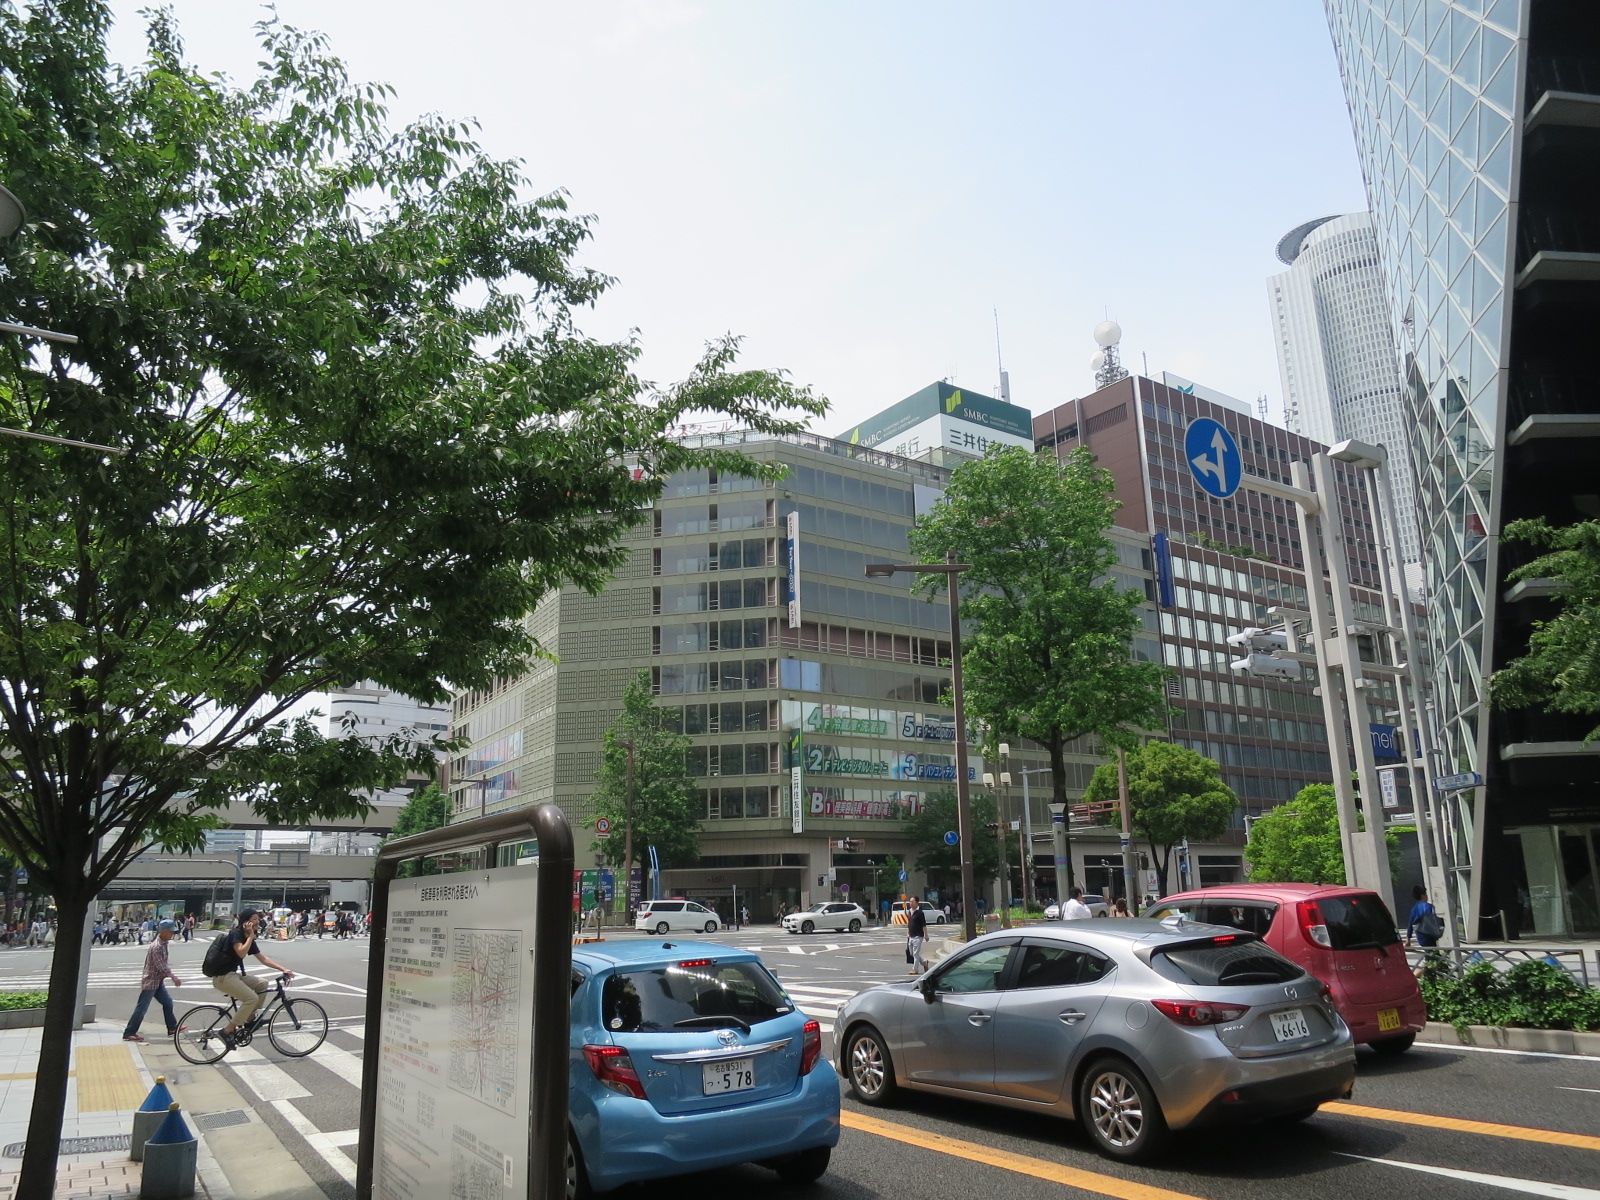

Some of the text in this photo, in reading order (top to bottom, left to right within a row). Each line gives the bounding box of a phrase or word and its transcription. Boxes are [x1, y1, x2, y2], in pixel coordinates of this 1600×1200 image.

[963, 407, 988, 424] SMBC
[793, 772, 801, 828] 三井住友銀行
